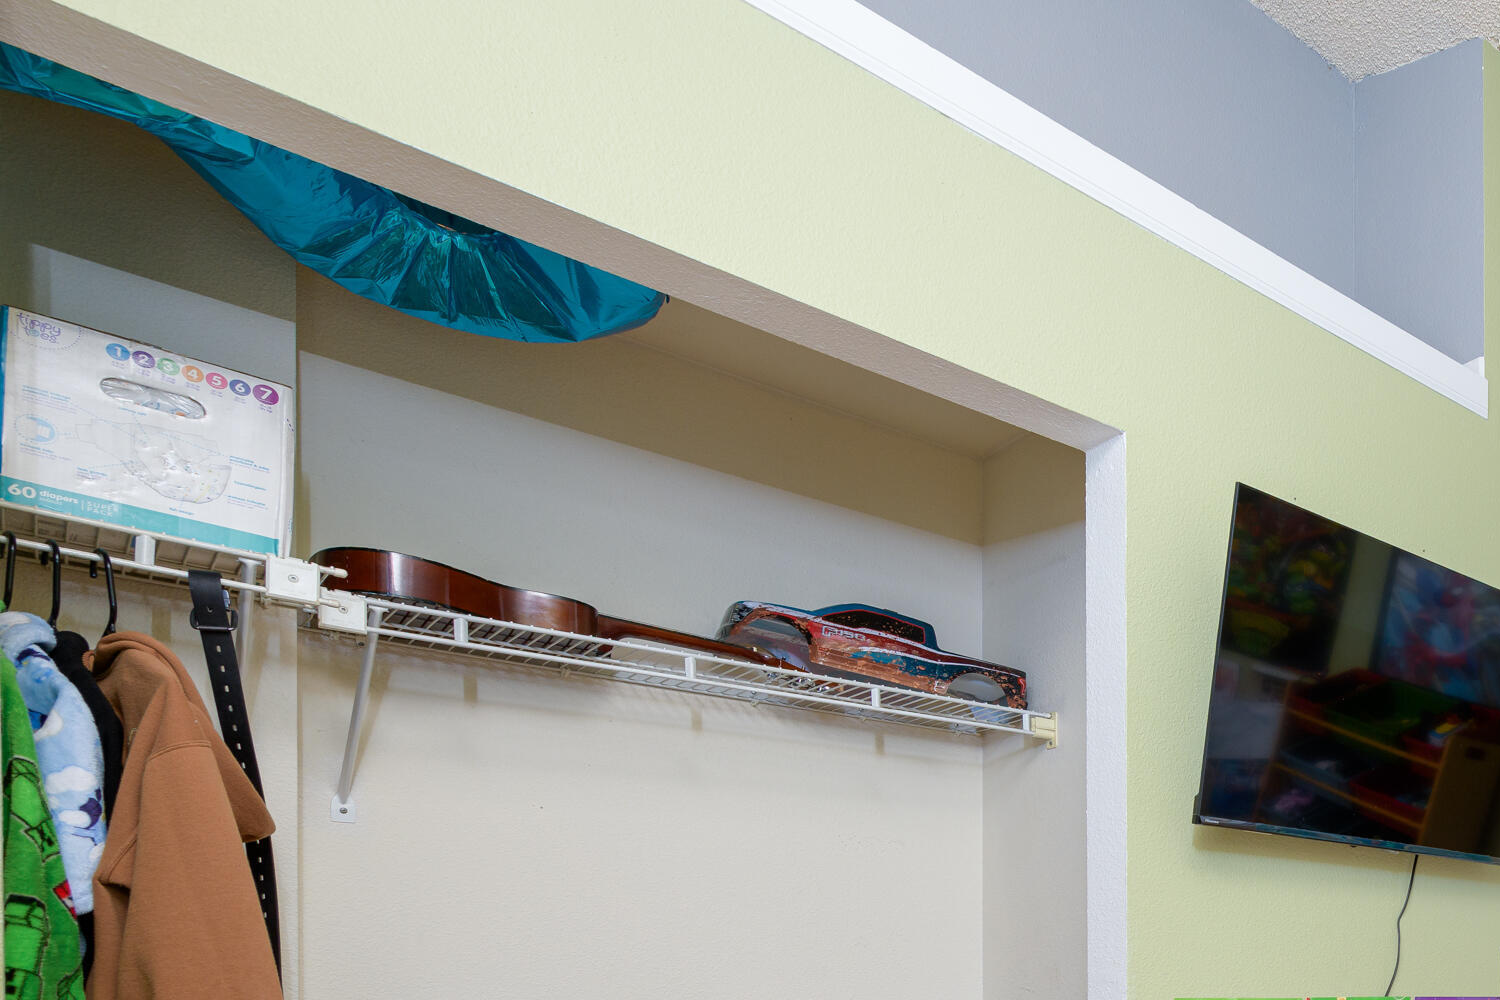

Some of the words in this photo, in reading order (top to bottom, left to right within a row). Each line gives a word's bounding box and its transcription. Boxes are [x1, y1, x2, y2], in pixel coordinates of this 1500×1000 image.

[16, 313, 61, 336] tippy
[138, 354, 150, 365] 2
[163, 361, 174, 372] 3
[188, 369, 200, 380] 4
[211, 376, 222, 387] 5
[235, 383, 245, 393] 6
[261, 388, 273, 400] 7
[8, 484, 37, 499] 60
[39, 490, 79, 504] diapers
